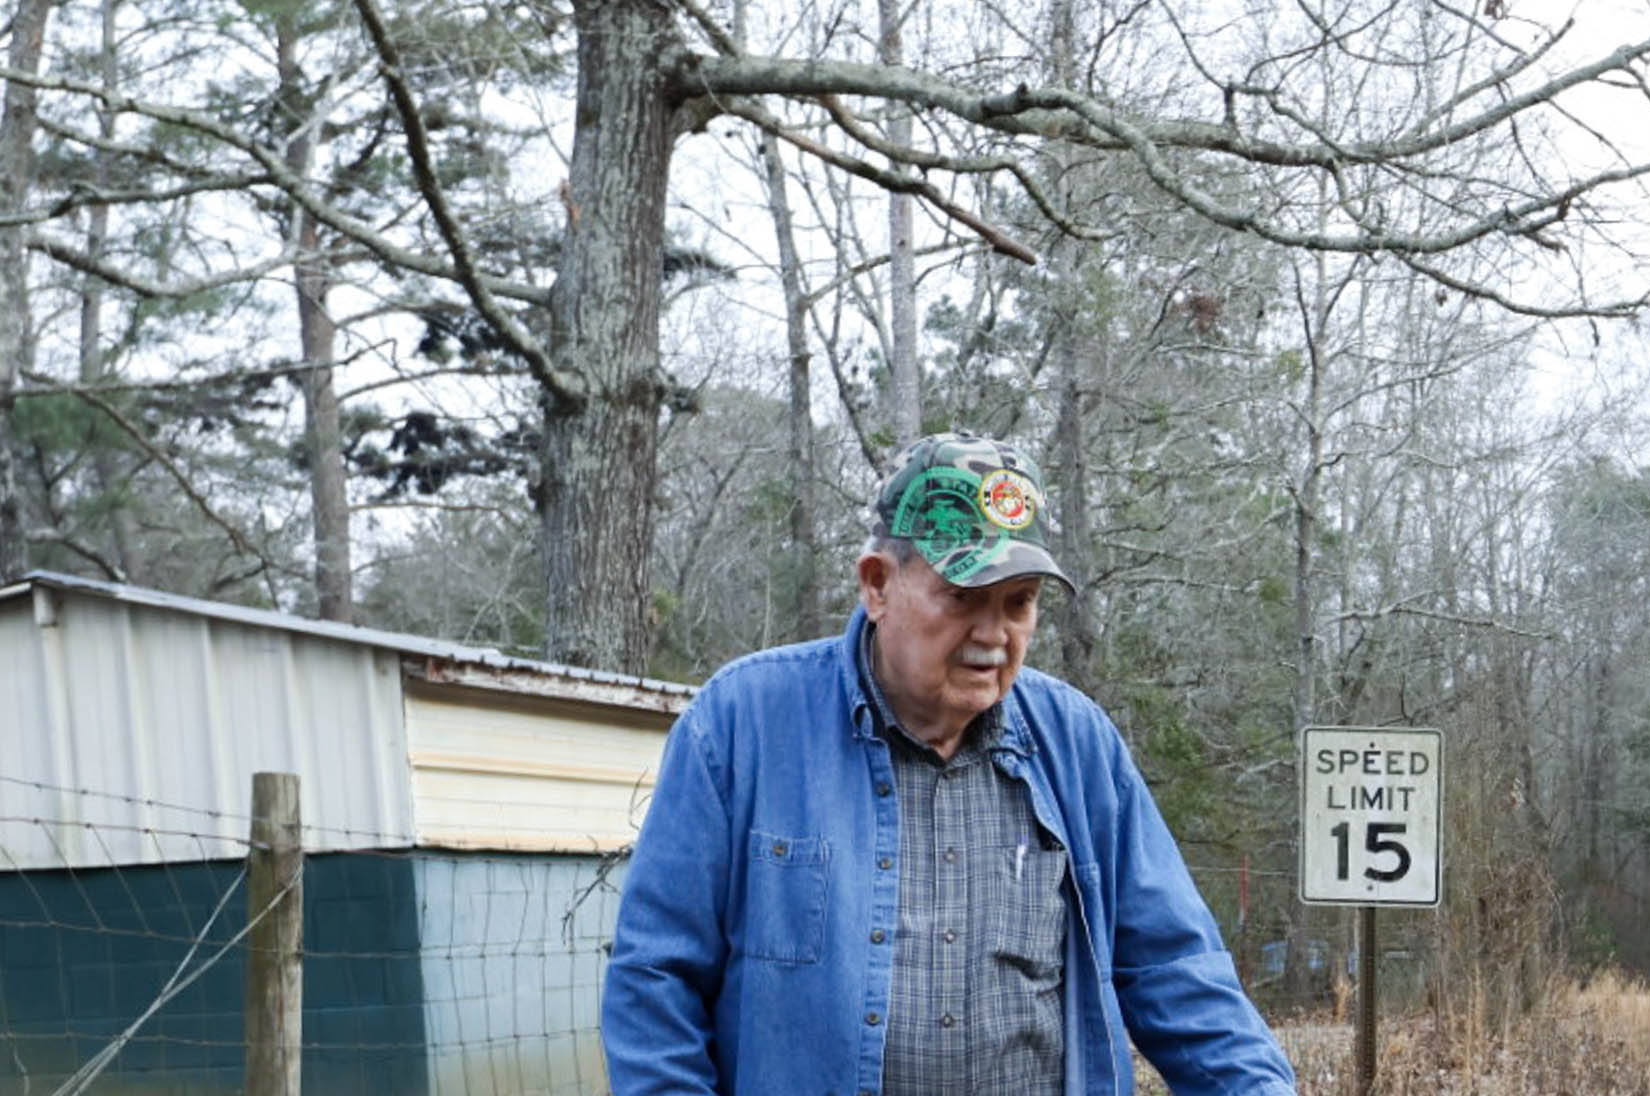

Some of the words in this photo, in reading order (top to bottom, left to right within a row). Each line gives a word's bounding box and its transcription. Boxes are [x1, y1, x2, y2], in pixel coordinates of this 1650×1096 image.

[1316, 749, 1430, 775] SPEED
[1327, 785, 1416, 811] LIMIT
[1330, 822, 1412, 883] 15
